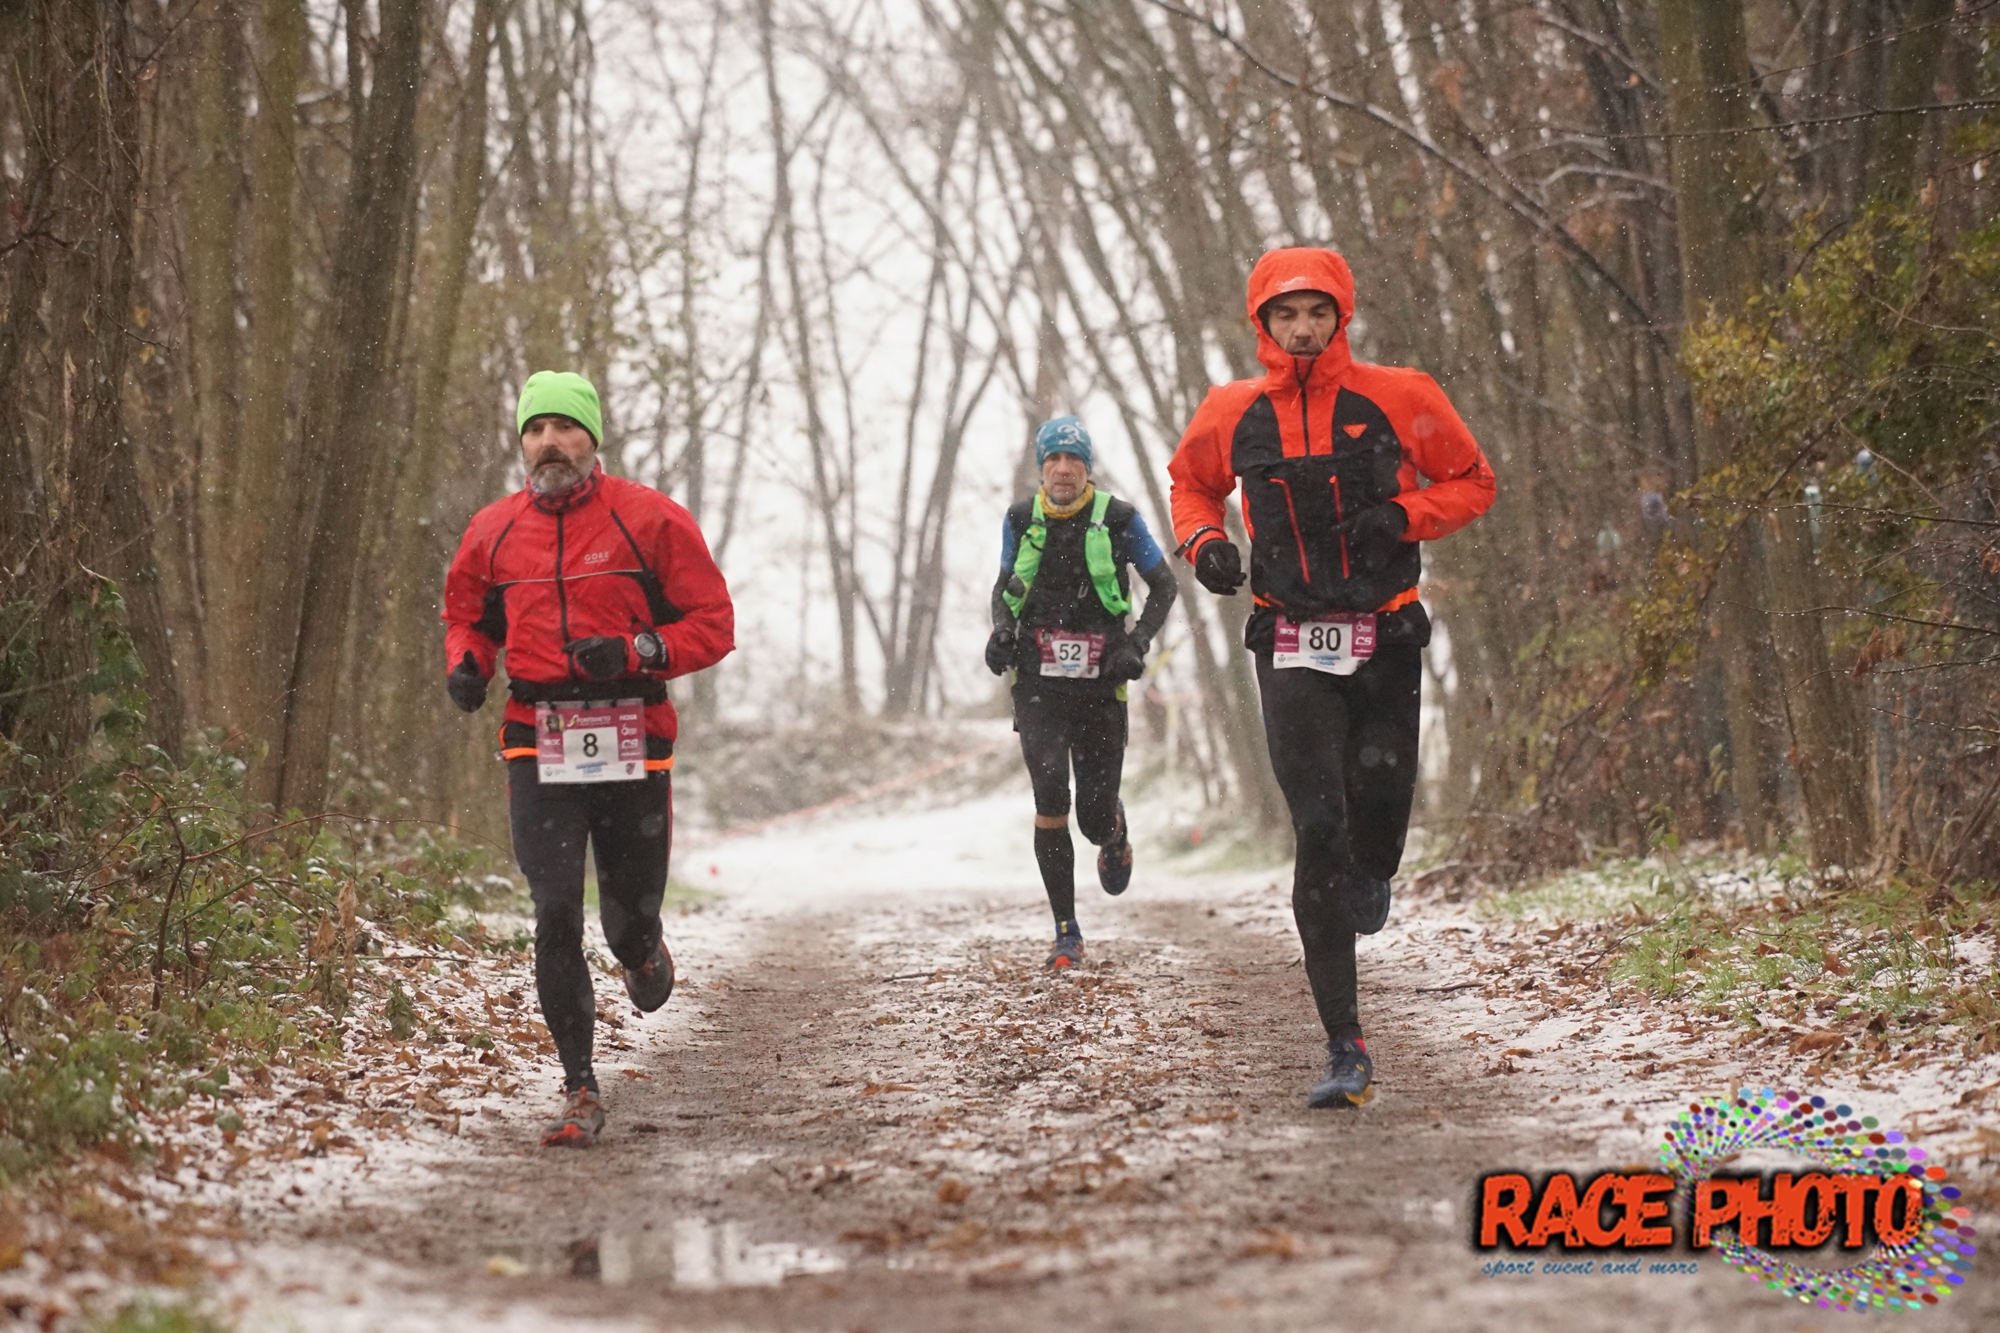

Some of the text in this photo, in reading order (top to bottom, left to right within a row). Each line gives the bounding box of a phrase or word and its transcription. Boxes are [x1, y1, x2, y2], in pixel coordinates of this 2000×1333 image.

[1309, 626, 1341, 652] 80
[1059, 643, 1081, 661] 52
[583, 733, 598, 758] 8
